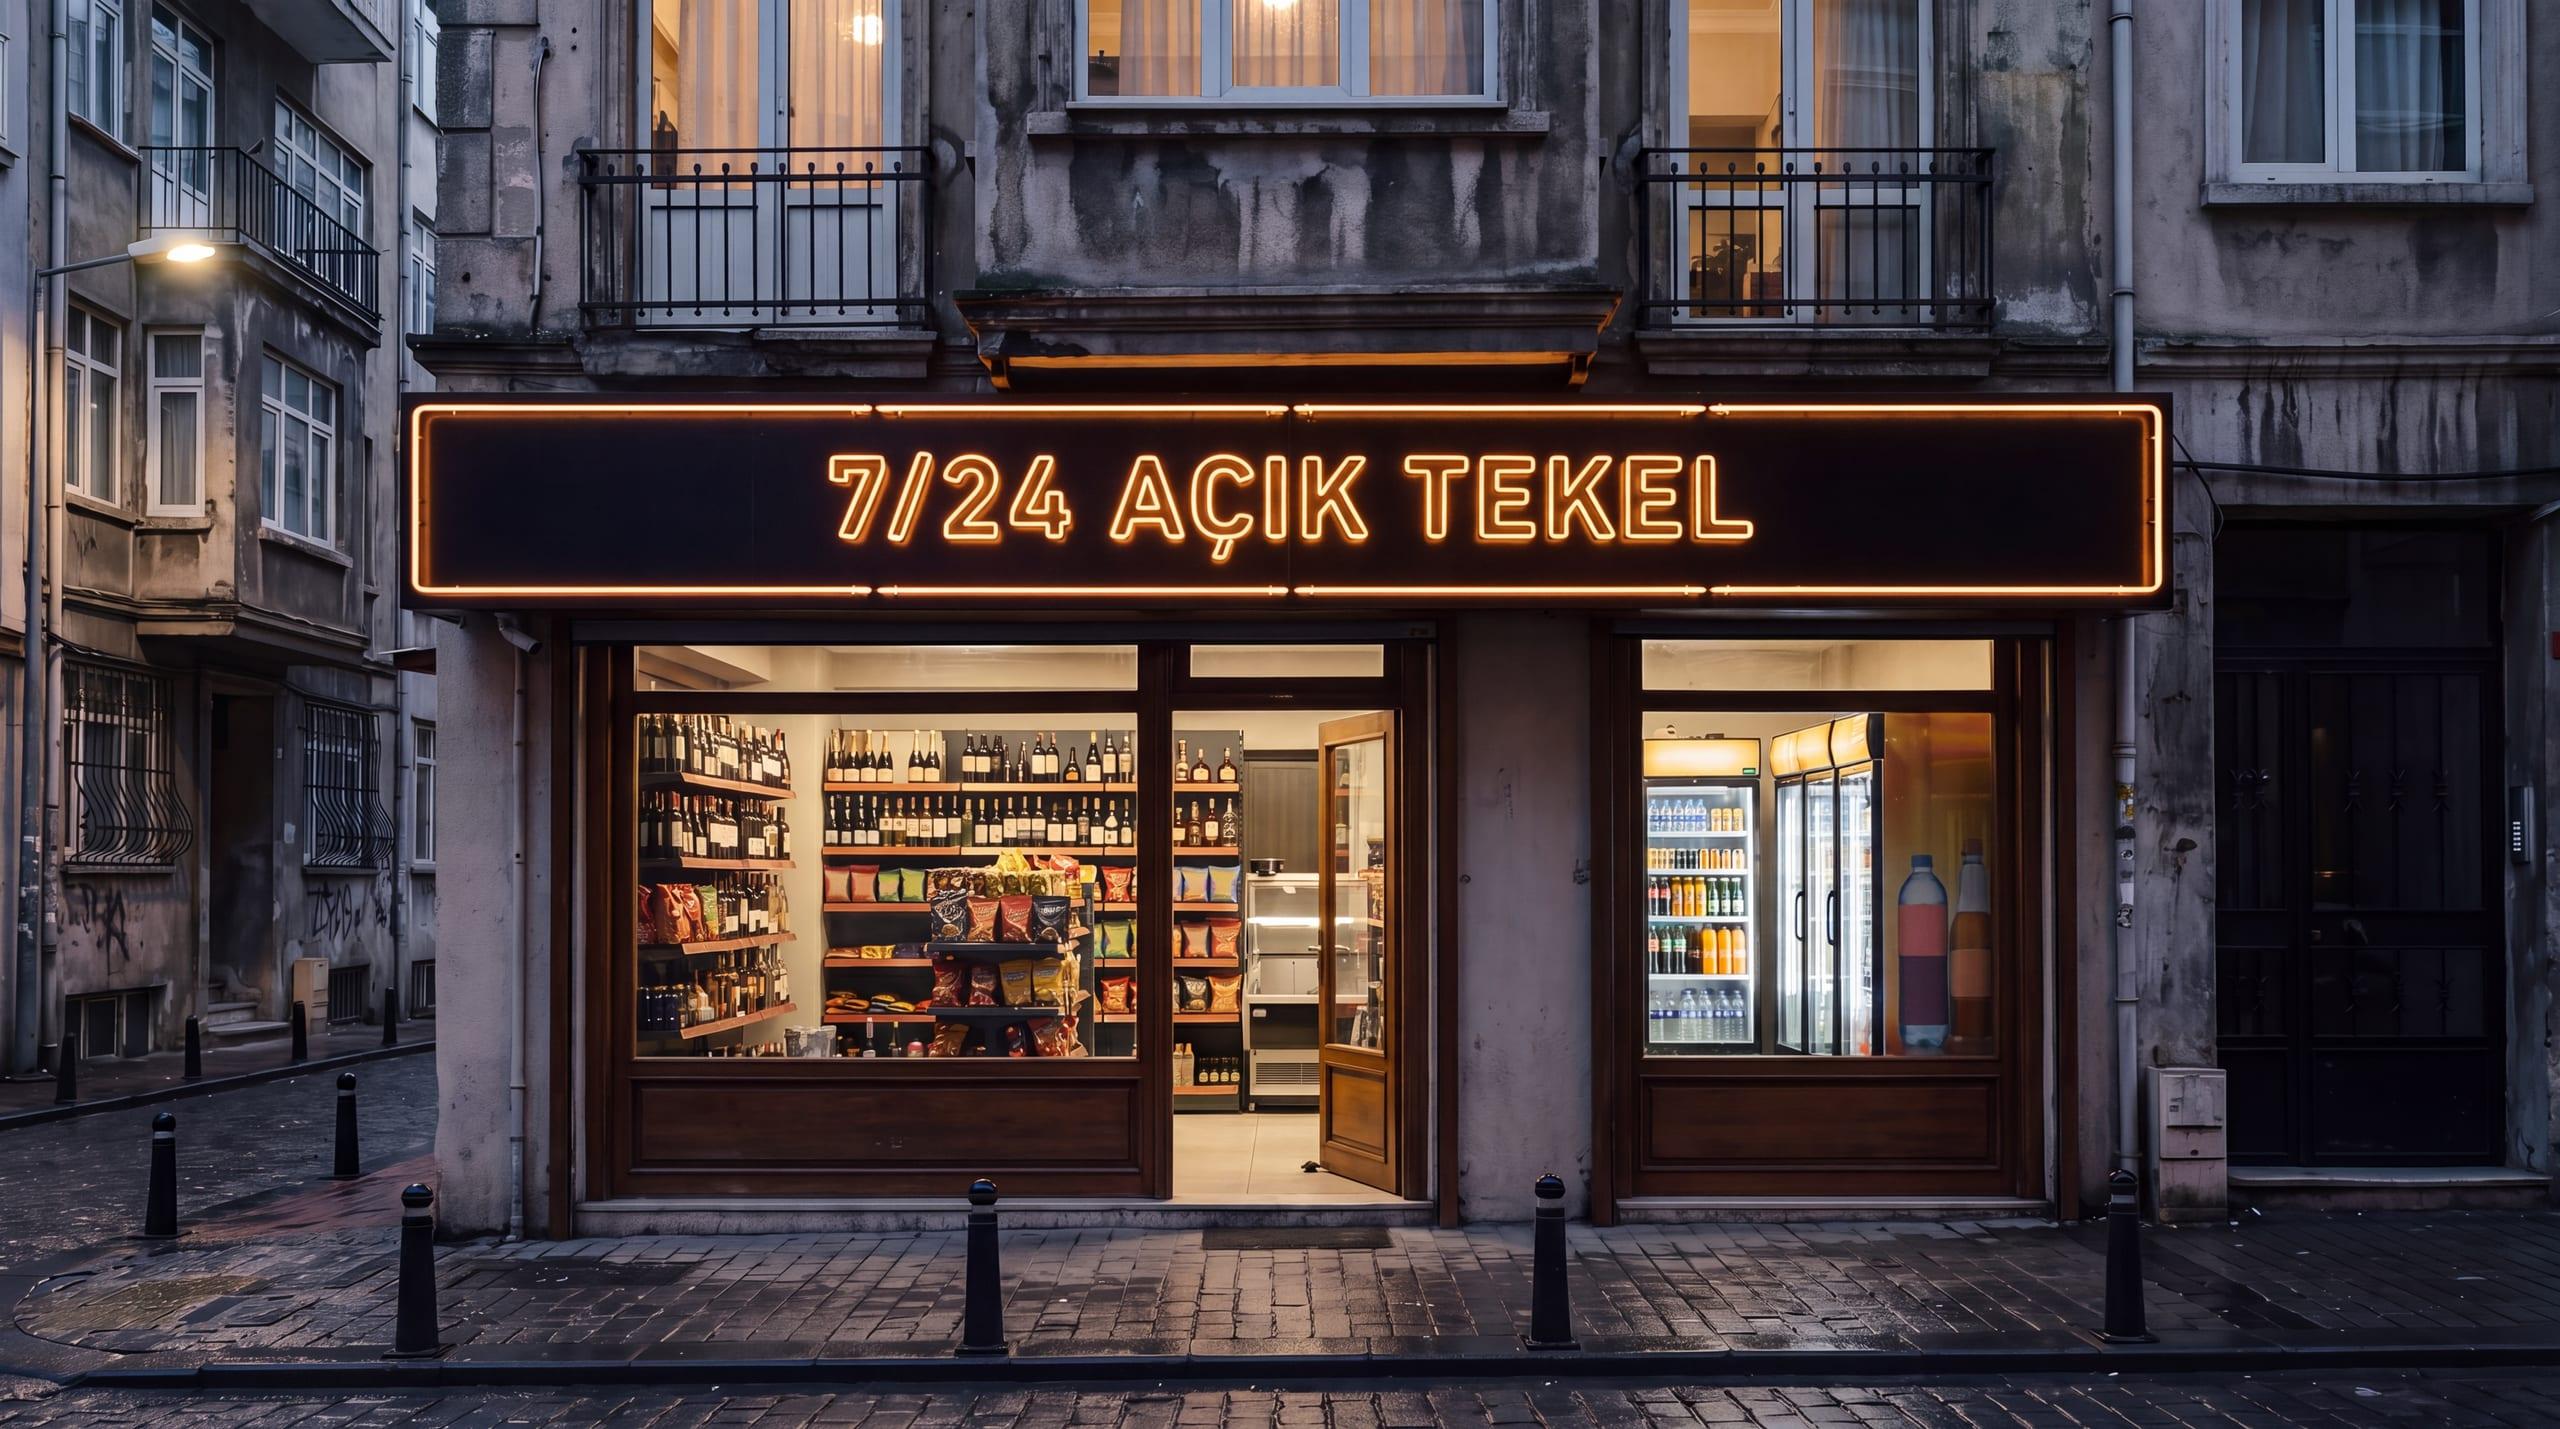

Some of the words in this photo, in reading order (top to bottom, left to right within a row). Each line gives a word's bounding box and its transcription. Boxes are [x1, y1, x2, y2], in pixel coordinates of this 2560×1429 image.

[828, 451, 1073, 545] 7/24
[1109, 453, 1369, 564] AÇIK
[1403, 454, 1754, 544] TEKEL
